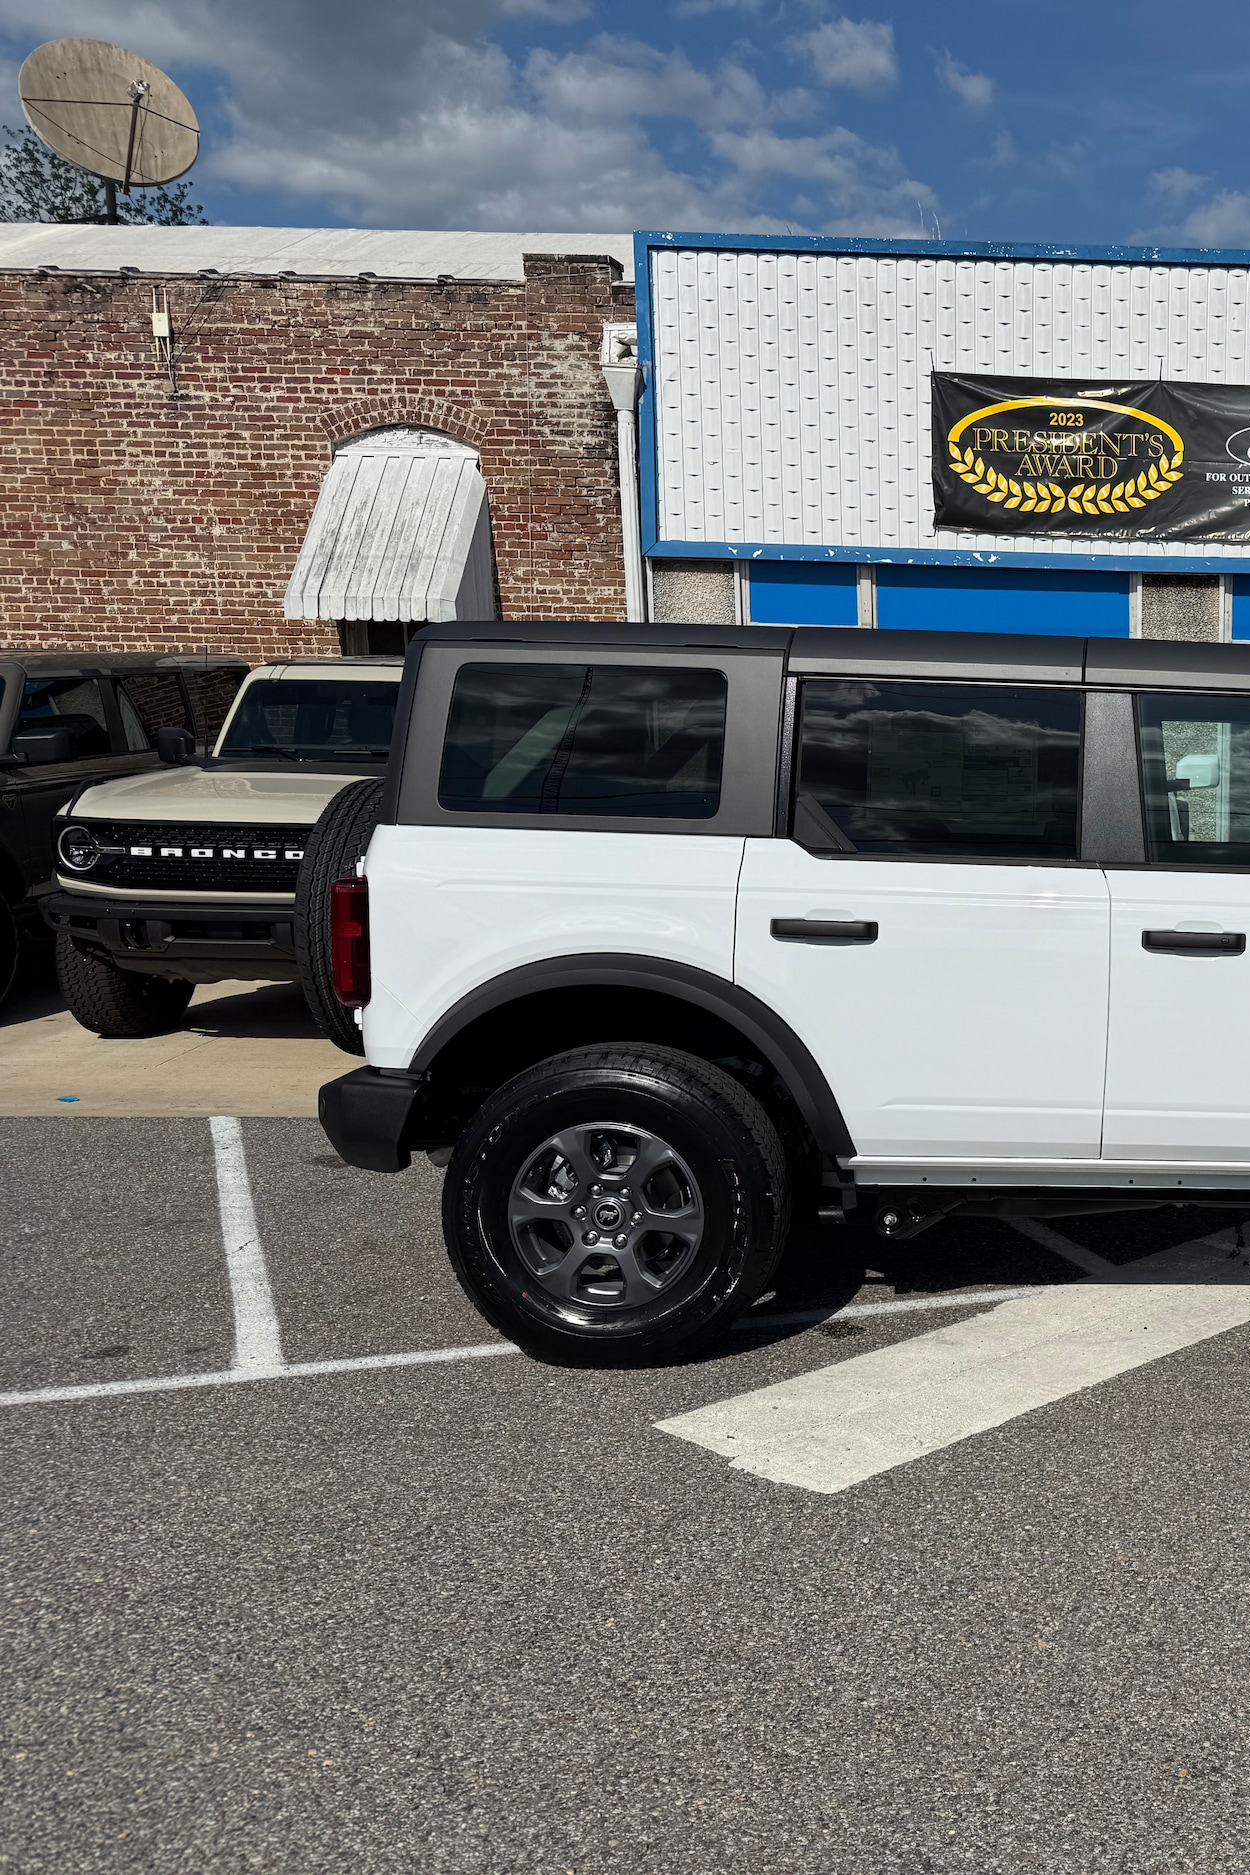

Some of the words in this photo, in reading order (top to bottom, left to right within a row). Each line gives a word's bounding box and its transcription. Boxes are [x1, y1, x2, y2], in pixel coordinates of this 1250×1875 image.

[1050, 413, 1084, 427] 2023
[1014, 454, 1118, 479] AWARD
[1205, 473, 1227, 482] FOR
[130, 846, 305, 859] BRONCO
